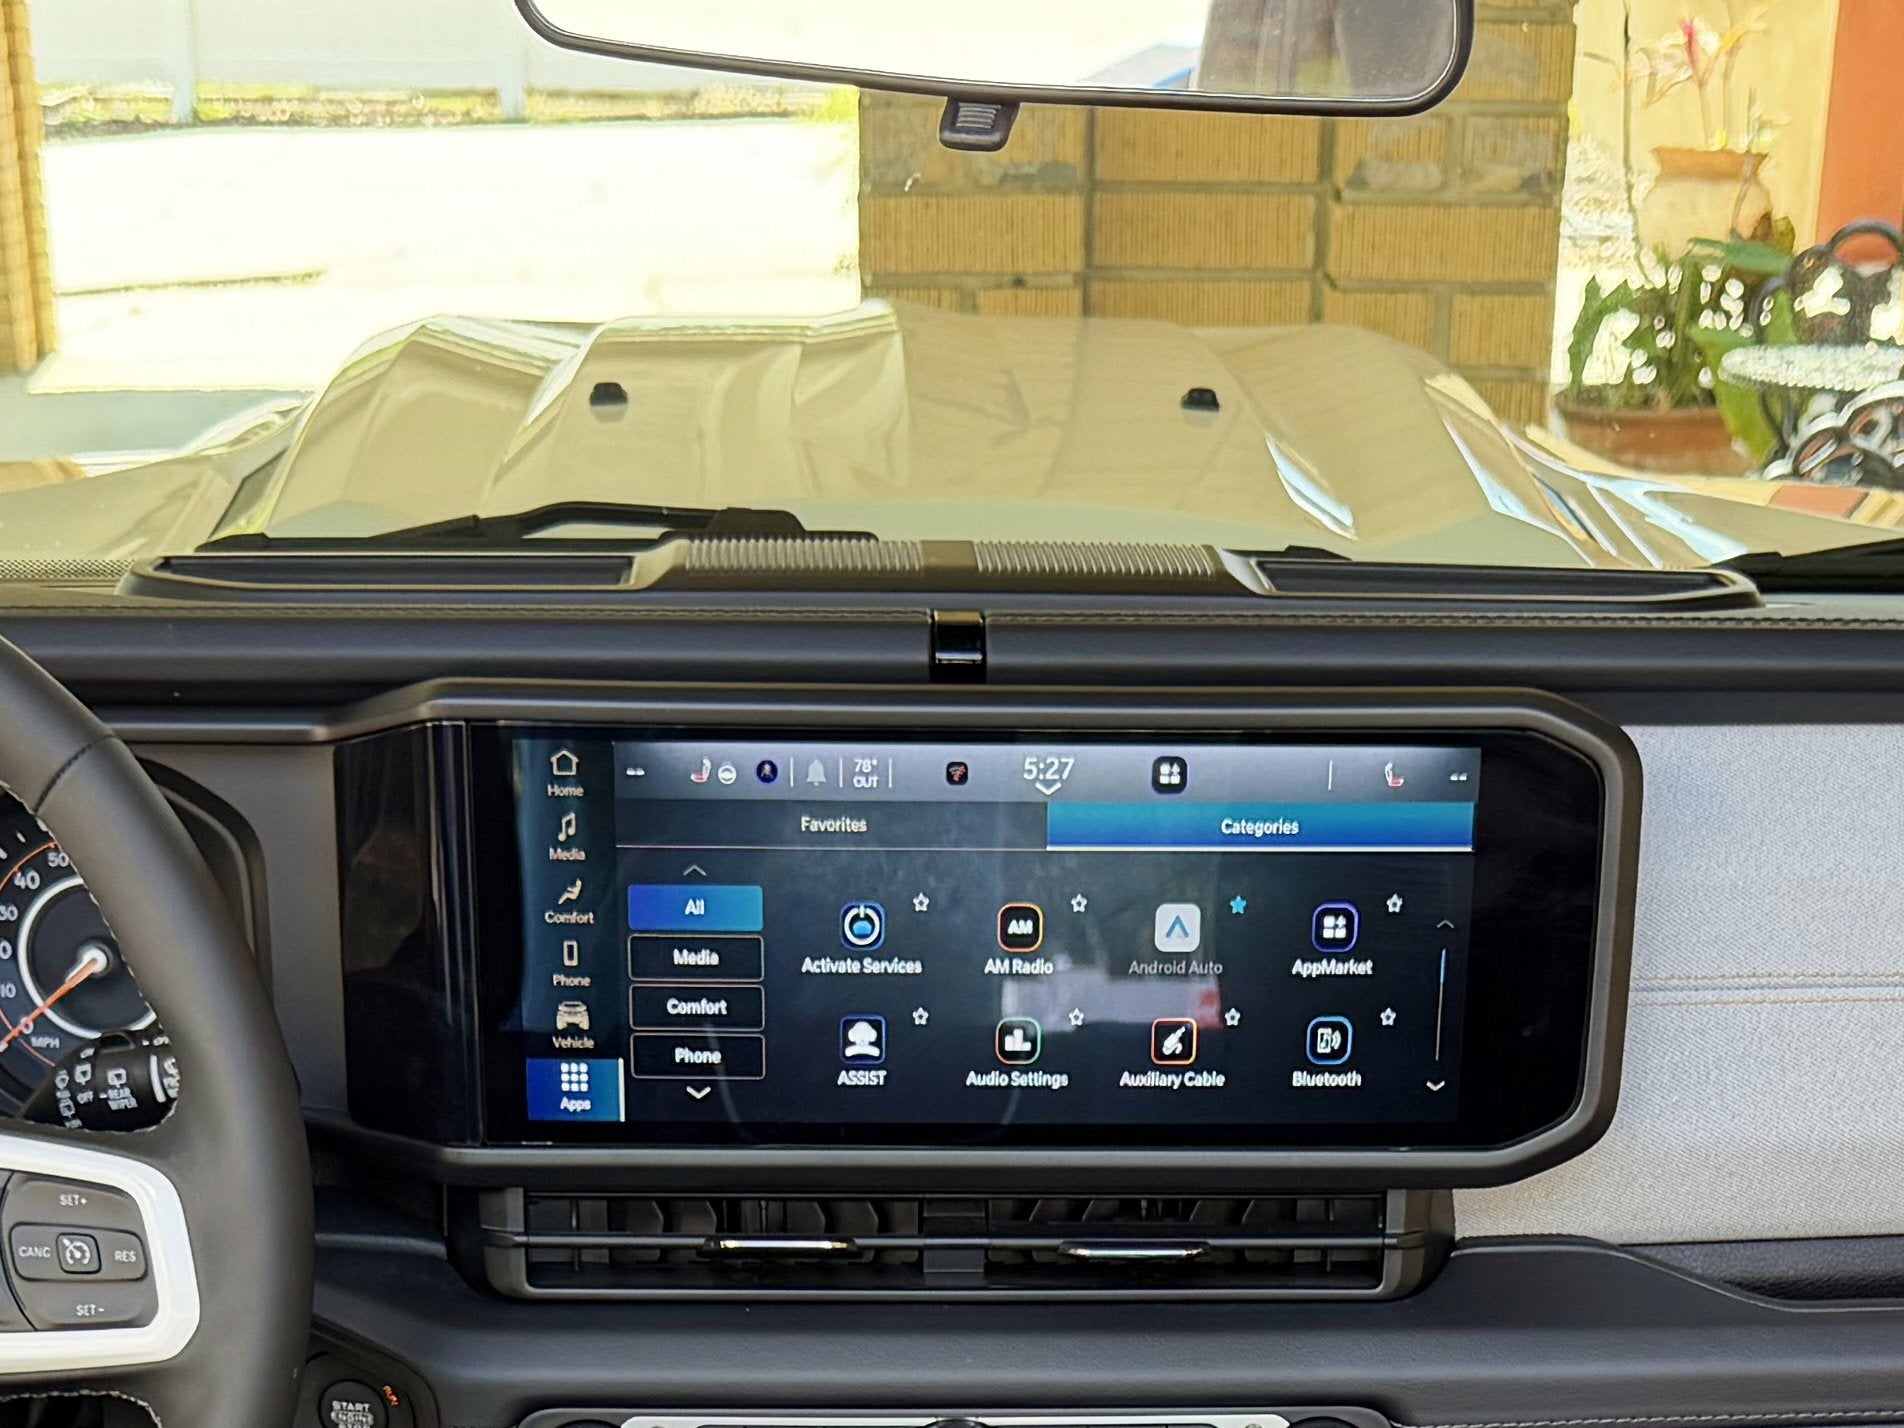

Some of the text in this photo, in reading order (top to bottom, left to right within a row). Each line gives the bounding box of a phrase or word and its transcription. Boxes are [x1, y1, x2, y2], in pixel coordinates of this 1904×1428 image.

[853, 758, 879, 773] 78°
[1023, 757, 1075, 781] 5:27
[547, 783, 584, 798] Home
[853, 776, 879, 789] OUT
[800, 816, 868, 833] Favorites
[1221, 818, 1300, 837] Categories
[549, 846, 586, 861] Media
[13, 870, 40, 889] 40
[684, 899, 705, 916] All
[544, 909, 595, 926] Comfort
[1007, 919, 1034, 935] AM
[673, 949, 720, 967] Media
[801, 958, 923, 975] Activate Services
[984, 958, 1054, 975] AM Radio
[1128, 958, 1223, 976] Android Auto
[1292, 959, 1373, 978] AppMarket
[552, 973, 591, 988] Phone
[0, 981, 17, 998] 10
[666, 998, 728, 1016] Comfort
[552, 1035, 595, 1051] Vehicle
[674, 1047, 723, 1065] Phone
[837, 1069, 888, 1087] ASSIST
[966, 1070, 1069, 1090] Audio Settings
[1120, 1069, 1226, 1090] Auxiliary Cable
[1292, 1070, 1362, 1088] Bluetooth
[559, 1096, 592, 1113] Apps
[18, 1245, 52, 1259] CANC
[114, 1250, 137, 1263] RES
[332, 1400, 370, 1412] START
